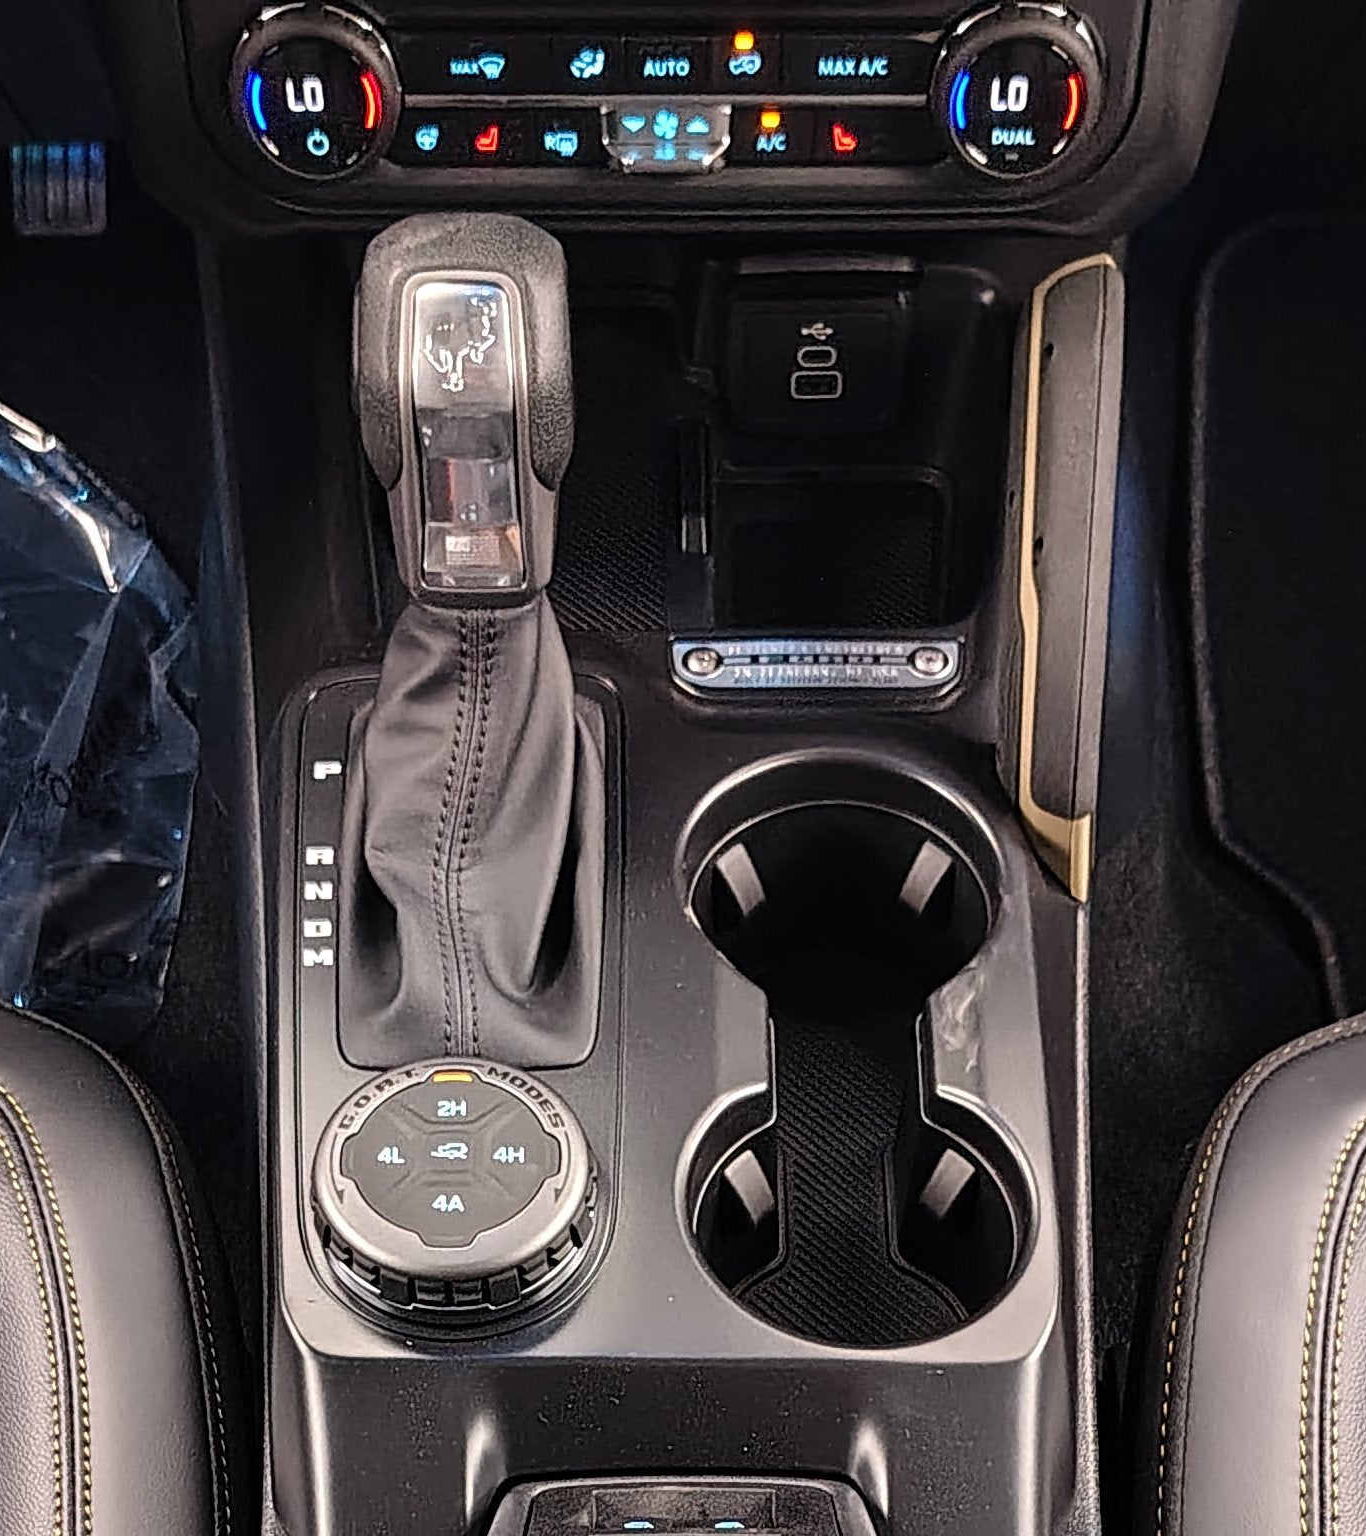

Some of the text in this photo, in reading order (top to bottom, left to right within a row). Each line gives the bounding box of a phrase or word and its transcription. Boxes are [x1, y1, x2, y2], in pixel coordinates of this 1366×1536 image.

[643, 60, 689, 77] AUTO
[818, 57, 889, 76] MAX A/C
[285, 77, 325, 113] LO
[990, 75, 1030, 112] LO
[756, 134, 786, 152] A/C
[991, 129, 1036, 146] DUAL
[313, 760, 343, 780] P
[303, 880, 334, 901] N
[303, 918, 333, 938] D
[302, 948, 334, 967] M
[486, 1066, 567, 1130] MODES
[436, 1100, 468, 1118] 2H
[377, 1146, 406, 1165] 4L
[492, 1146, 526, 1165] 4H
[431, 1193, 466, 1213] 4A
